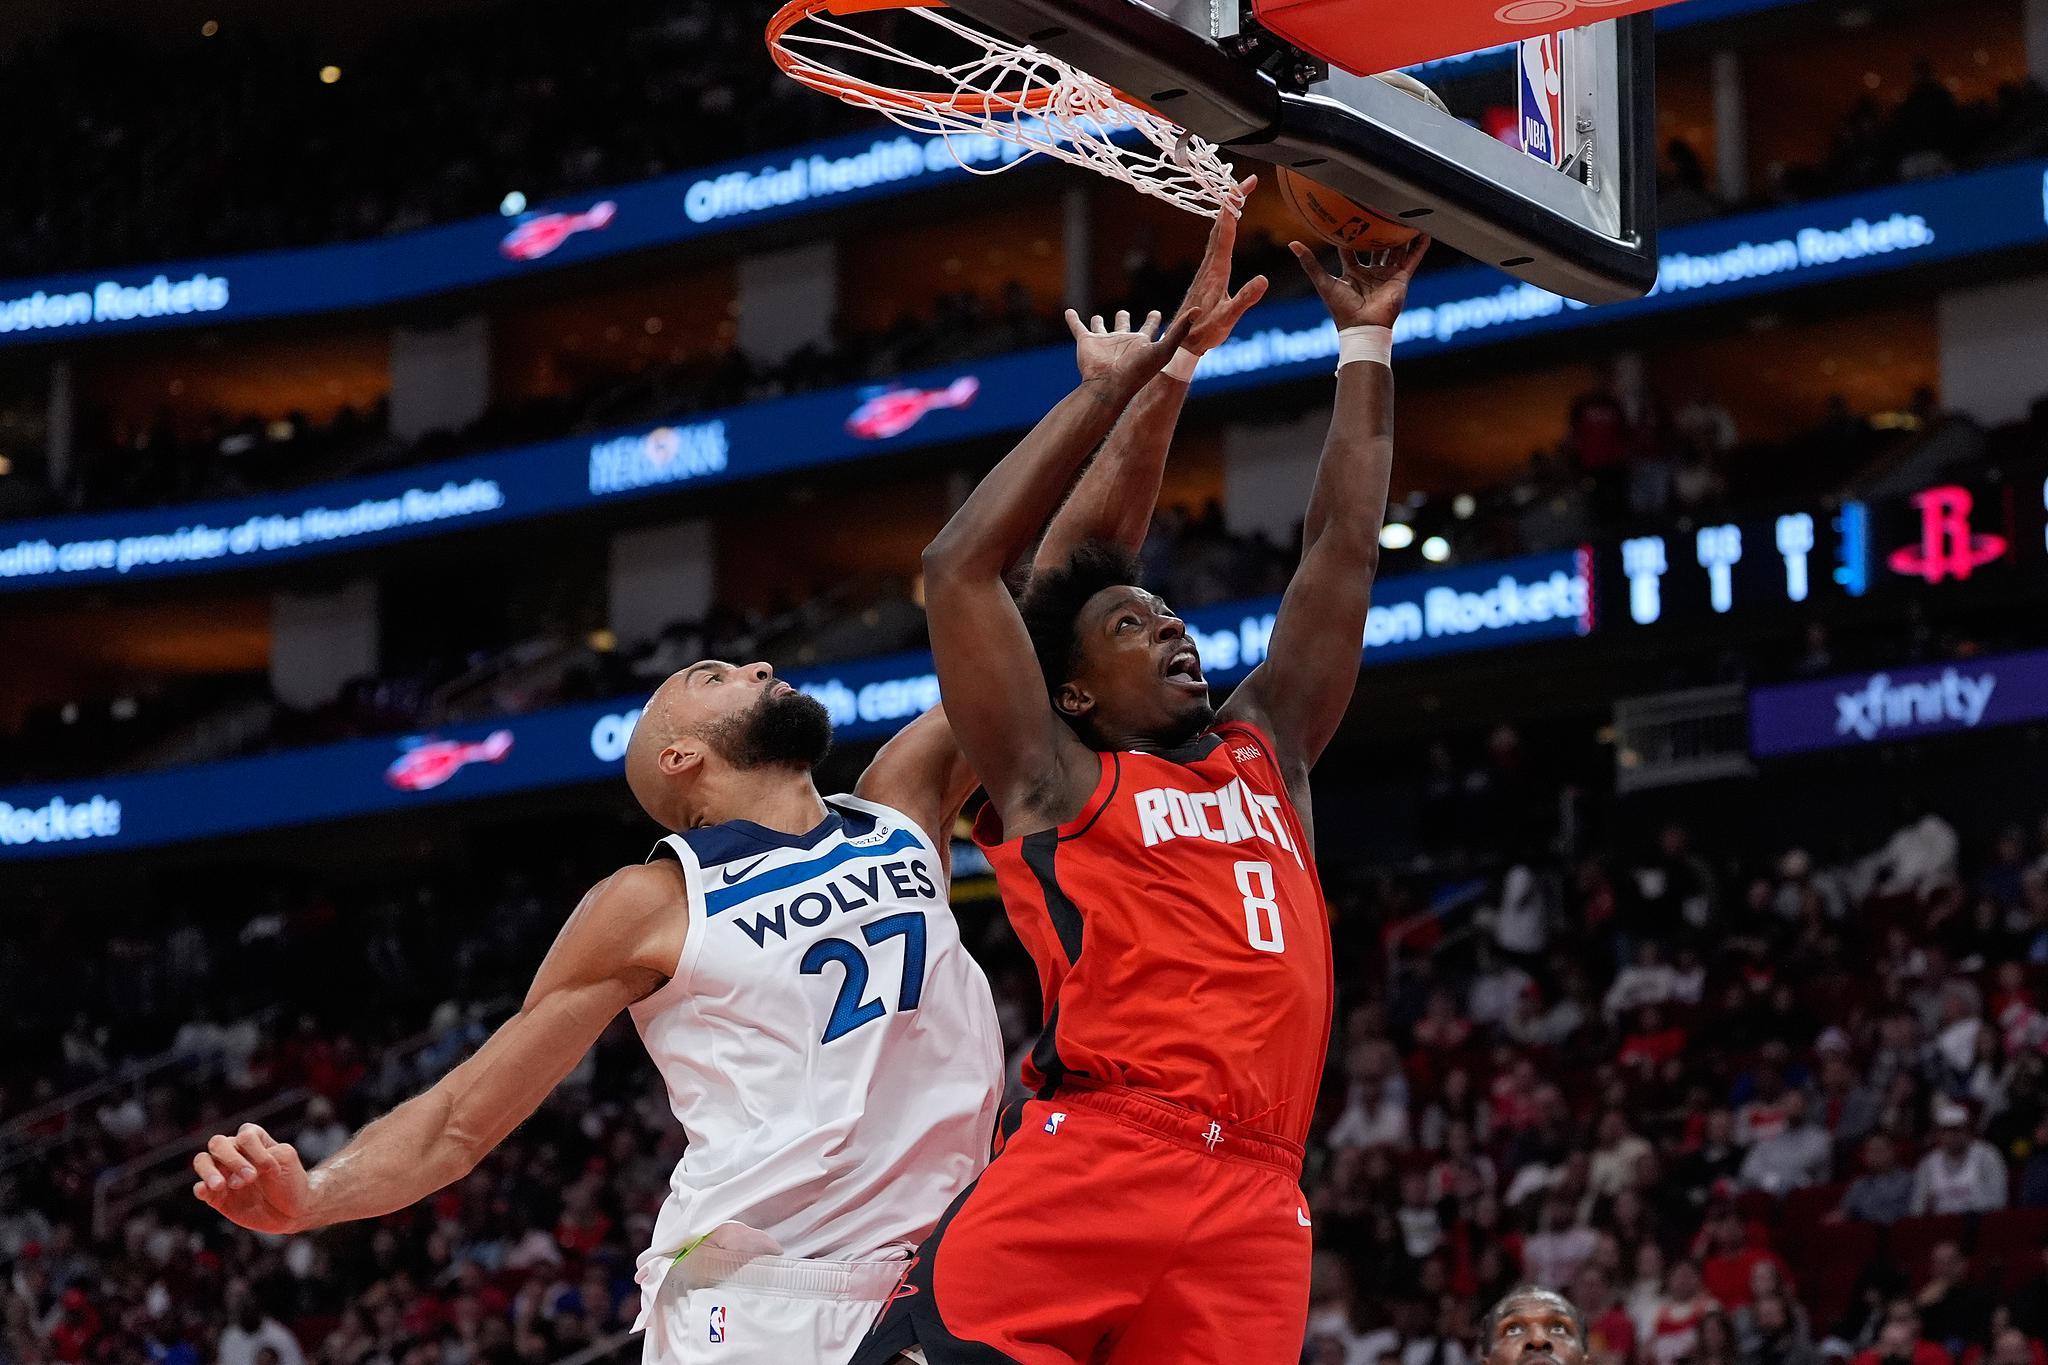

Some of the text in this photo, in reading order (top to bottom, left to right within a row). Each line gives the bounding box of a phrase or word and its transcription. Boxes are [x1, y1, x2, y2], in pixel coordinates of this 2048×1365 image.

[1525, 115, 1547, 153] NBA
[0, 290, 92, 333] uston
[1425, 570, 1588, 637] Rockets
[1836, 667, 1996, 741] xfinity
[1134, 776, 1305, 870] ROCKET
[732, 859, 937, 949] WOLVES
[1233, 860, 1285, 954] 8
[800, 911, 927, 1045] 27
